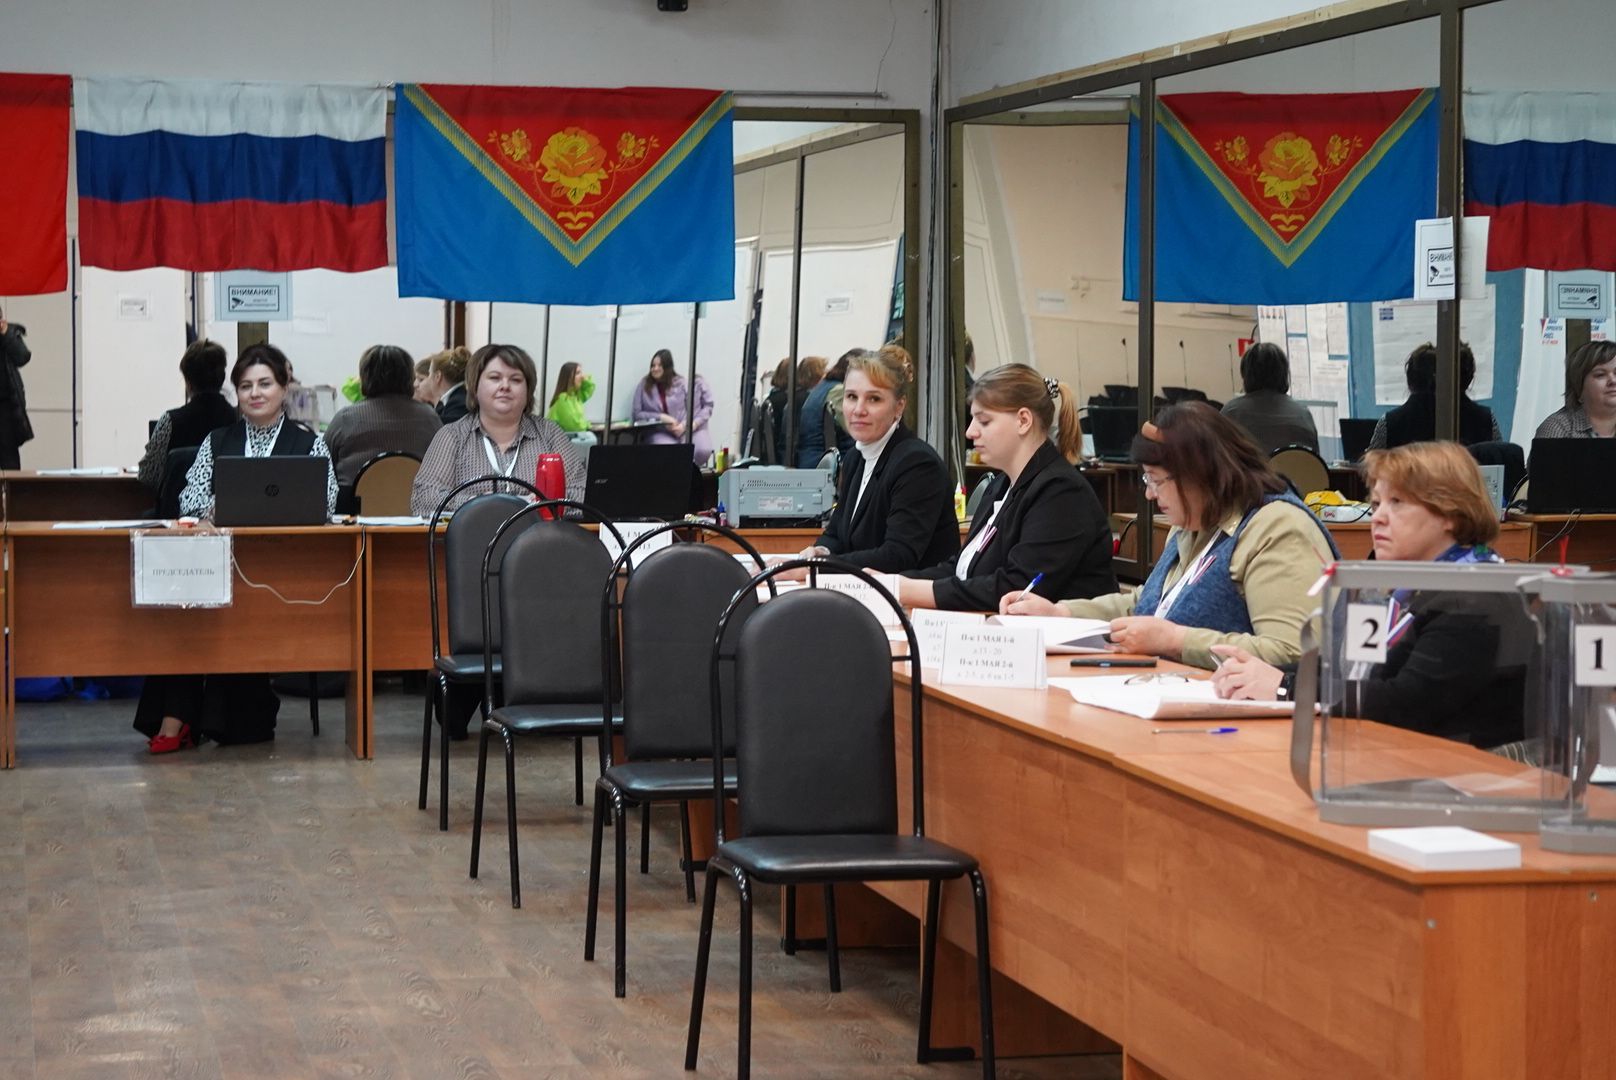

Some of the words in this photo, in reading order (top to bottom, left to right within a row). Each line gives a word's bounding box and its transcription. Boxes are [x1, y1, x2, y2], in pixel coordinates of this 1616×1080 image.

[152, 568, 215, 577] ПРЕДСЕДАТЕЛЬ
[1361, 618, 1379, 649] 2
[983, 634, 1002, 643] МАЯ
[1593, 637, 1607, 671] 1
[981, 659, 1001, 668] МАЯ
